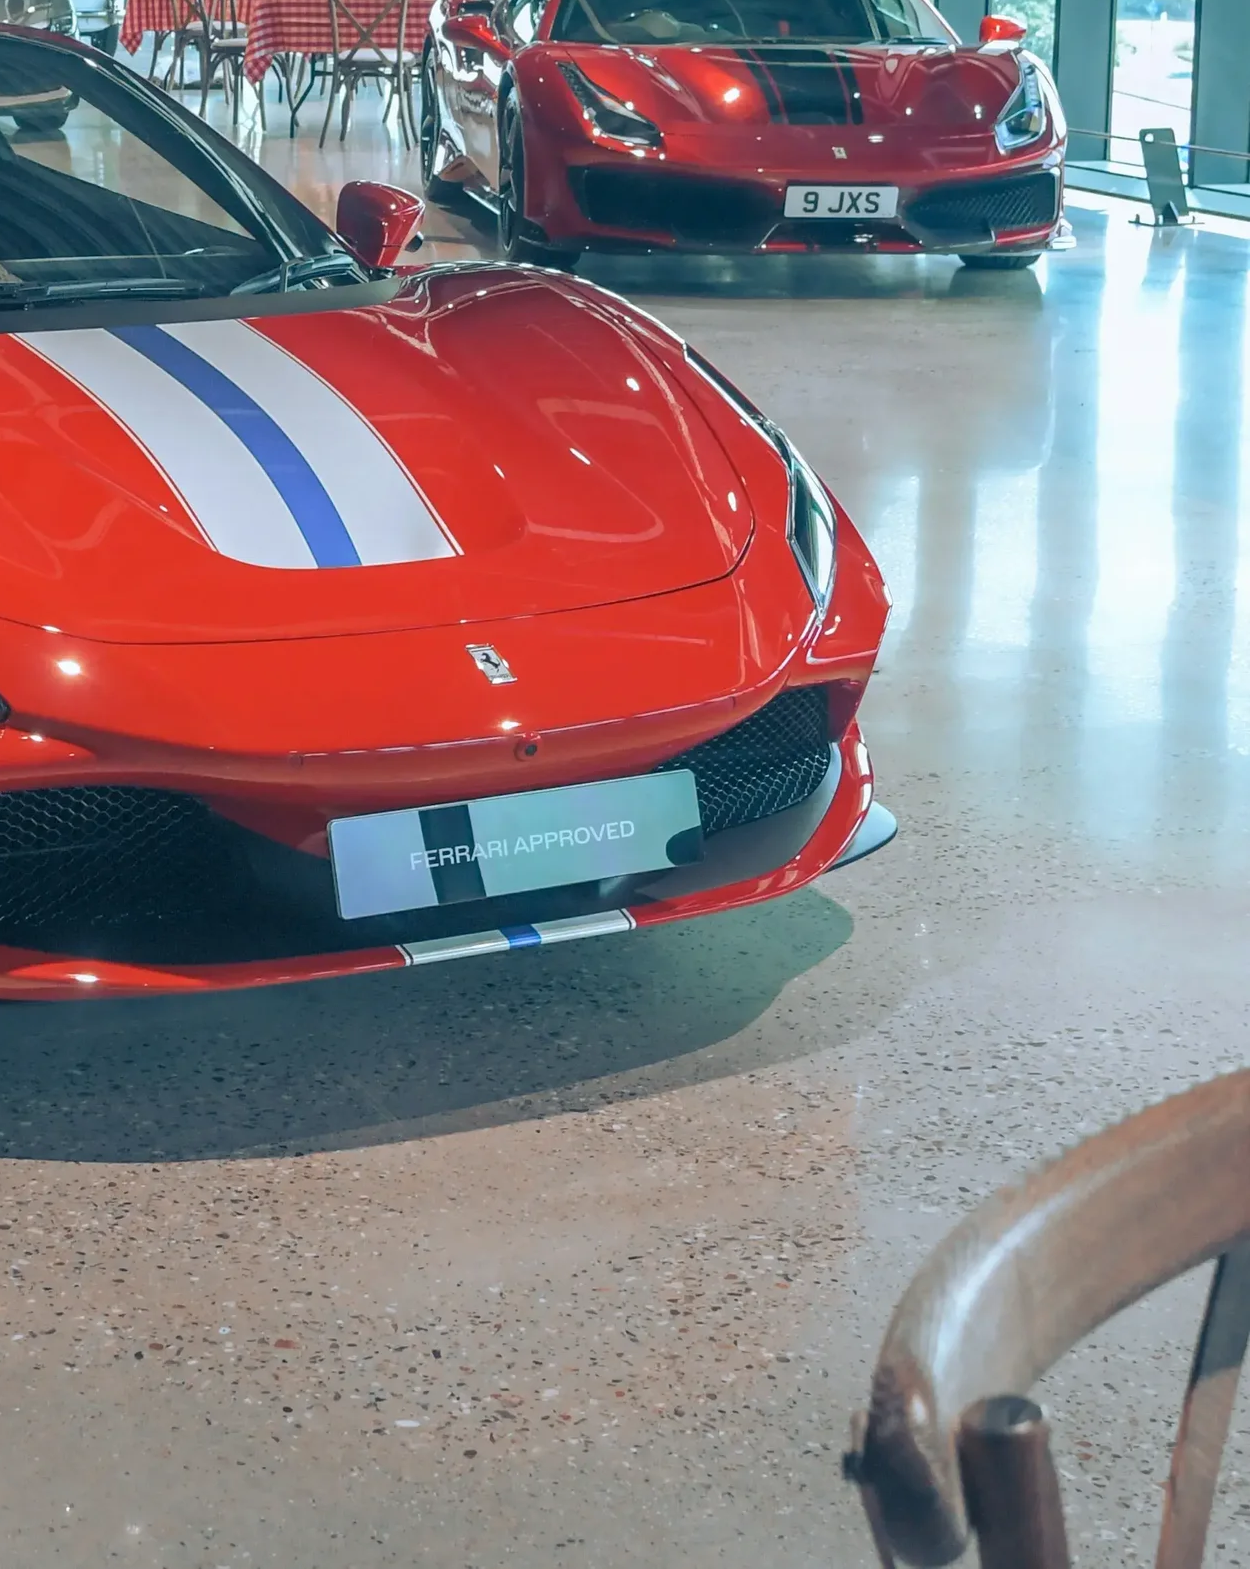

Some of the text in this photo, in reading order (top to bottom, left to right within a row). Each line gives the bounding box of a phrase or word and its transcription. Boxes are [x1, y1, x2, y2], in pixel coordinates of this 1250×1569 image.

[802, 191, 881, 214] 9 JXS
[410, 820, 635, 871] FERRARI APPROVED
